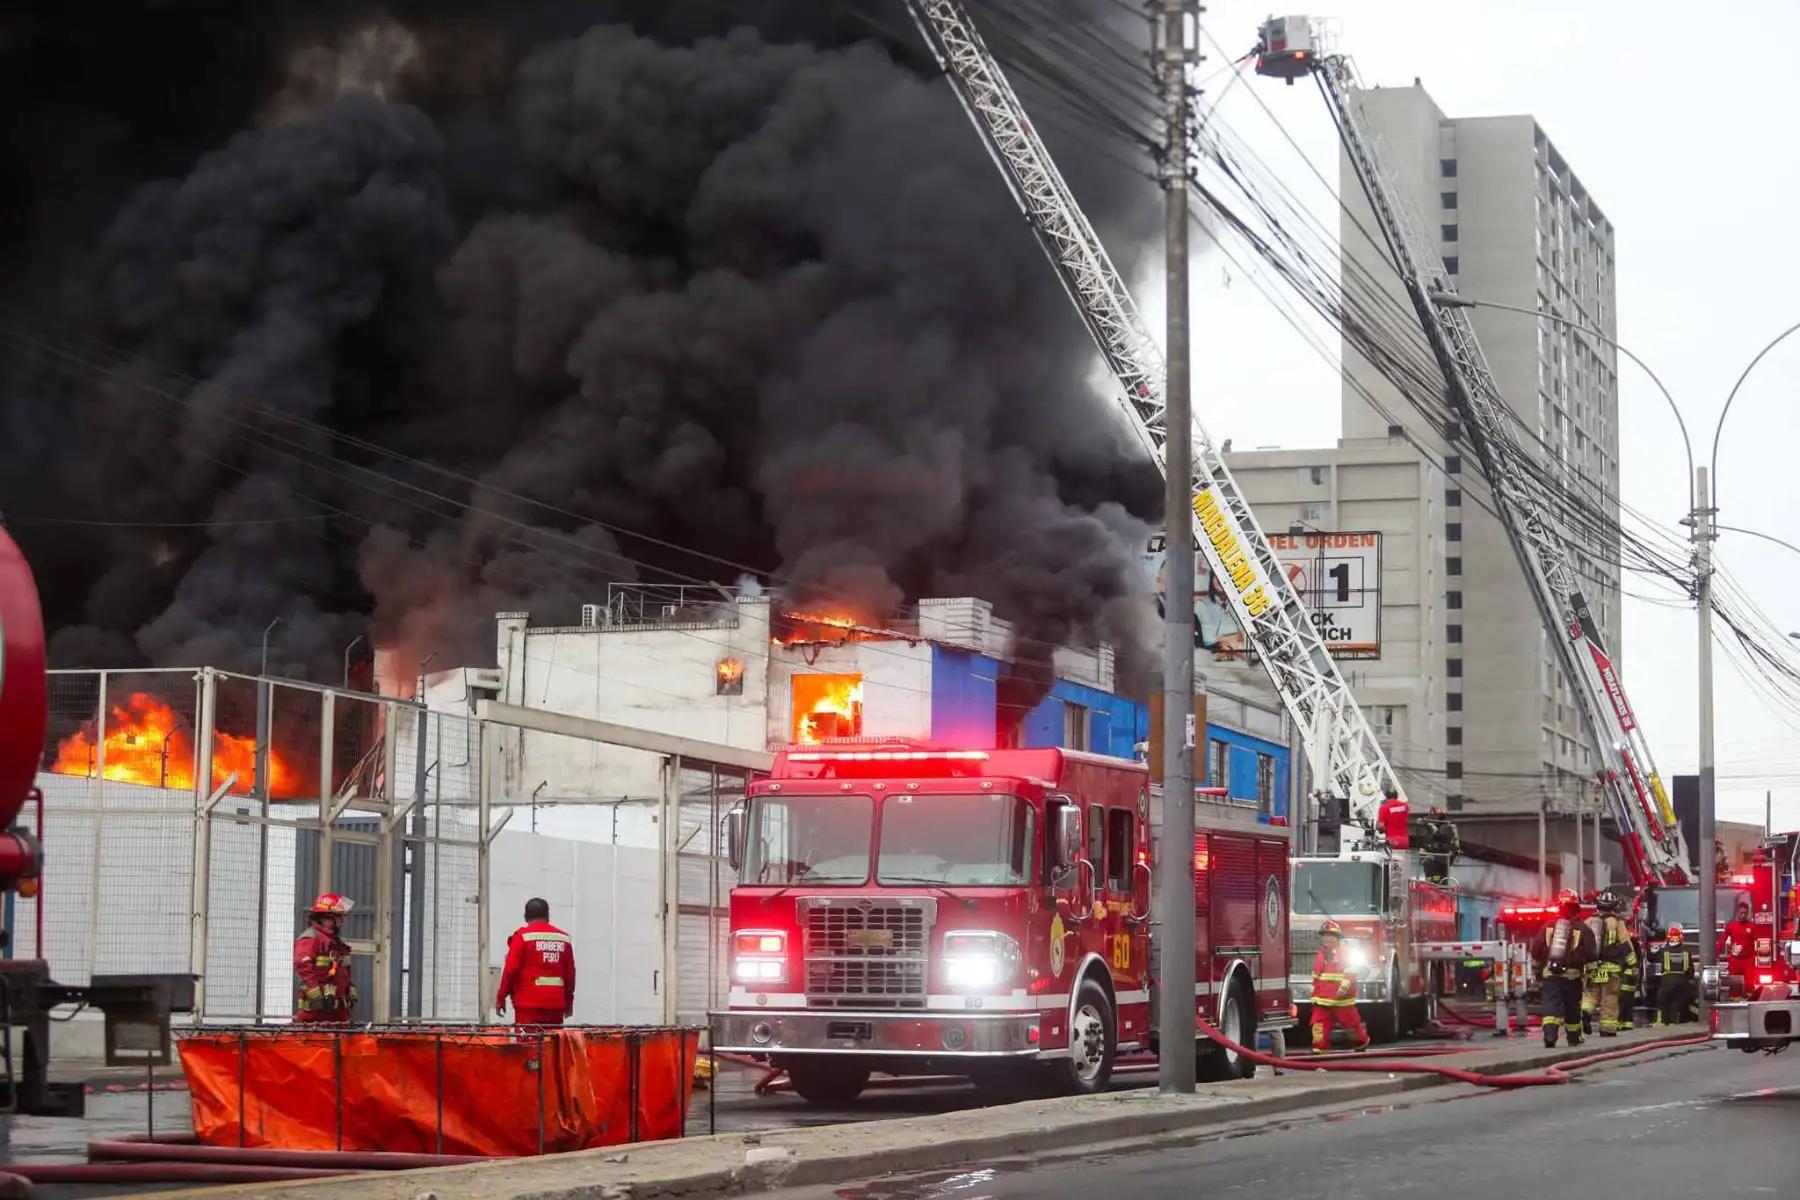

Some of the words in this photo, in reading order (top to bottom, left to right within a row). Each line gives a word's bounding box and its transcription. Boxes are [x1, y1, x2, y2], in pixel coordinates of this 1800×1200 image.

[1192, 488, 1257, 594] MAGDALENA
[1243, 585, 1271, 617] 36
[1304, 533, 1374, 549] ORDEN
[1329, 563, 1349, 602] 1
[1316, 627, 1352, 641] ICH
[1113, 934, 1130, 969] 60
